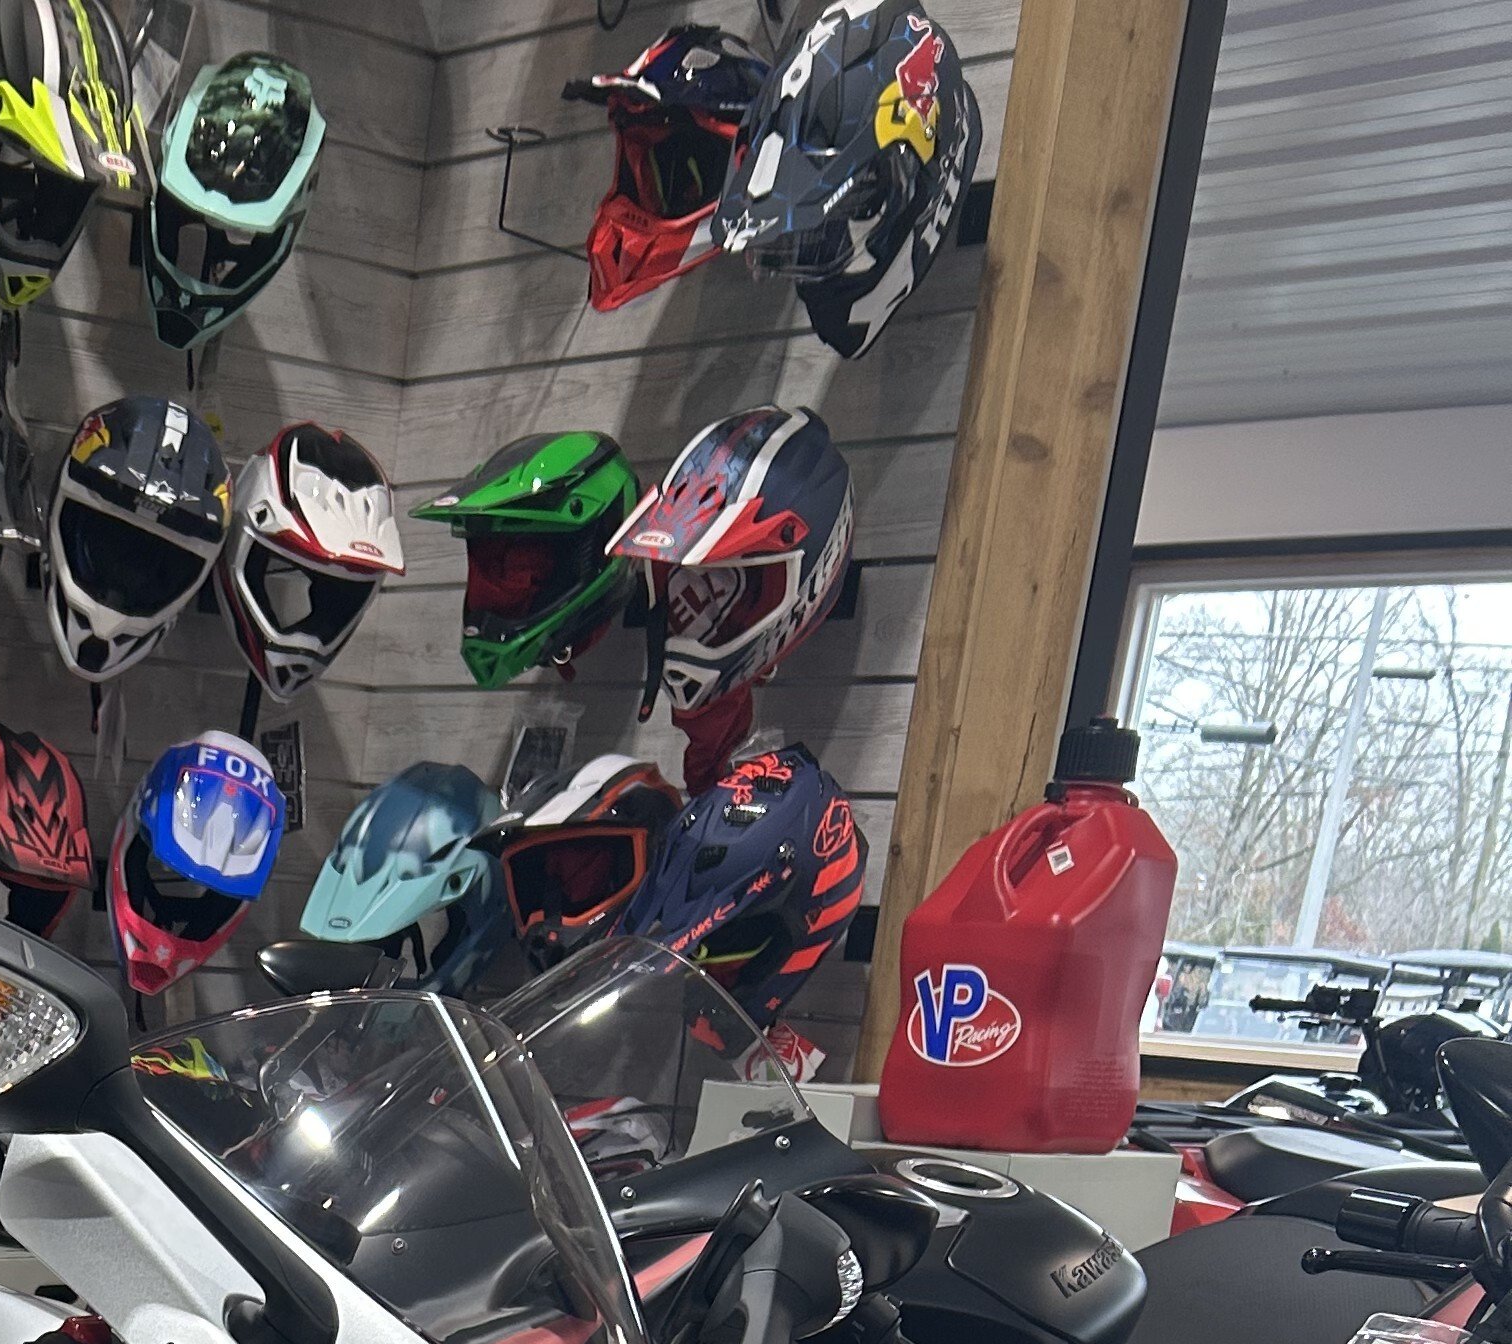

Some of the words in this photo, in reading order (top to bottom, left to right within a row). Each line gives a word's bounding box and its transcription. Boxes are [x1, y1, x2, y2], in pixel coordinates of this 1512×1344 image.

[106, 156, 131, 170] BELL
[198, 746, 273, 797] FOX
[914, 963, 989, 1063] VP
[953, 1020, 1018, 1055] Racing
